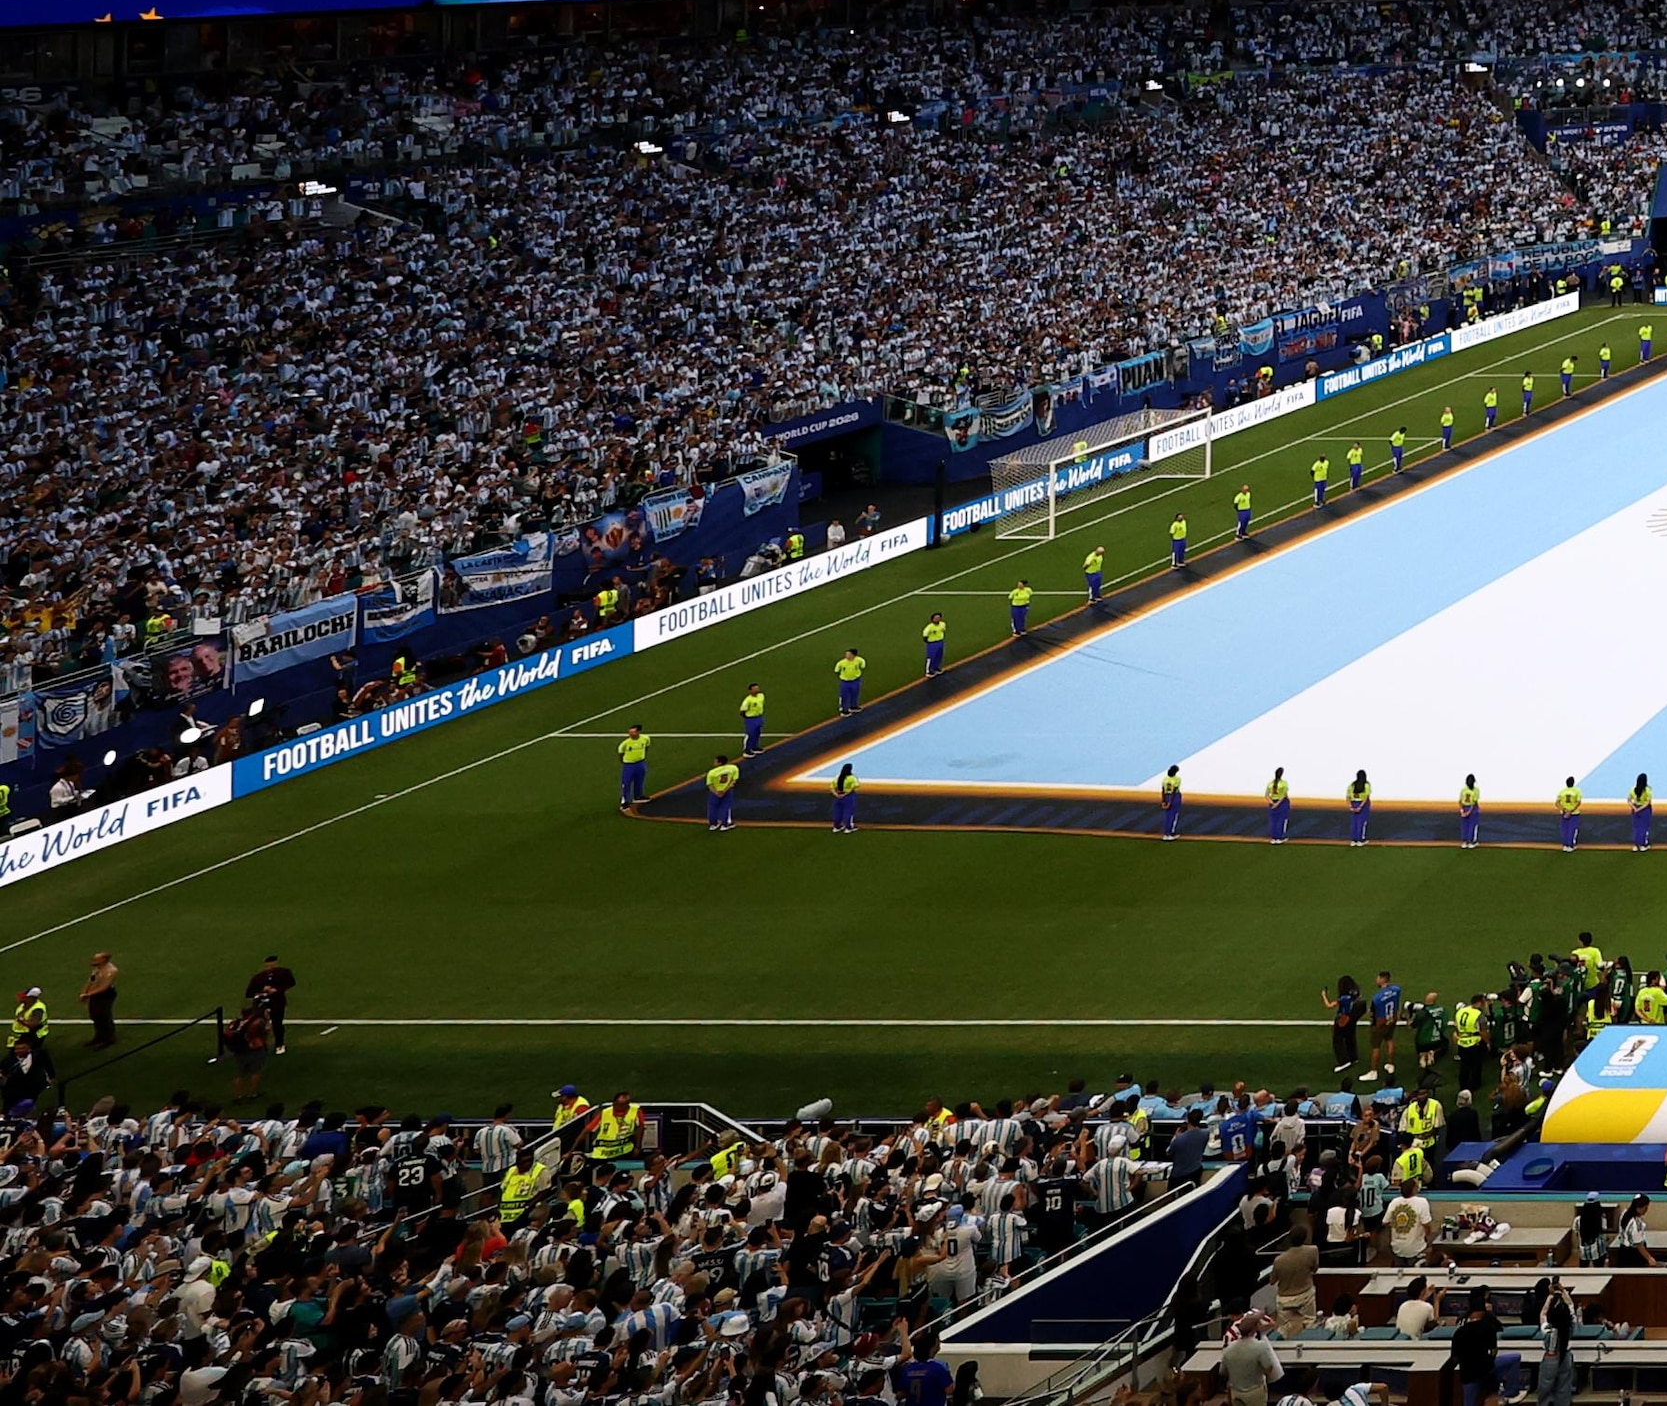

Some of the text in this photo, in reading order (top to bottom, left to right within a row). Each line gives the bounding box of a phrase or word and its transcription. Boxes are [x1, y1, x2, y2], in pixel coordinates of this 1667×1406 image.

[1341, 304, 1364, 322] FIFA
[1121, 359, 1164, 389] PUAN
[774, 412, 860, 443] WORLD CUP 2026
[942, 452, 1132, 534] FOOTBALL UNITES World FIFA
[659, 533, 910, 636] FOOTBALL UNITES the World FIFA
[239, 610, 355, 662] BARILOCHE
[264, 637, 615, 780] FOOTBALL UNITES the World FIFA
[42, 785, 203, 862] World FIFA
[398, 1165, 425, 1187] 23
[1045, 1195, 1062, 1212] 10
[1360, 1187, 1376, 1209] 10
